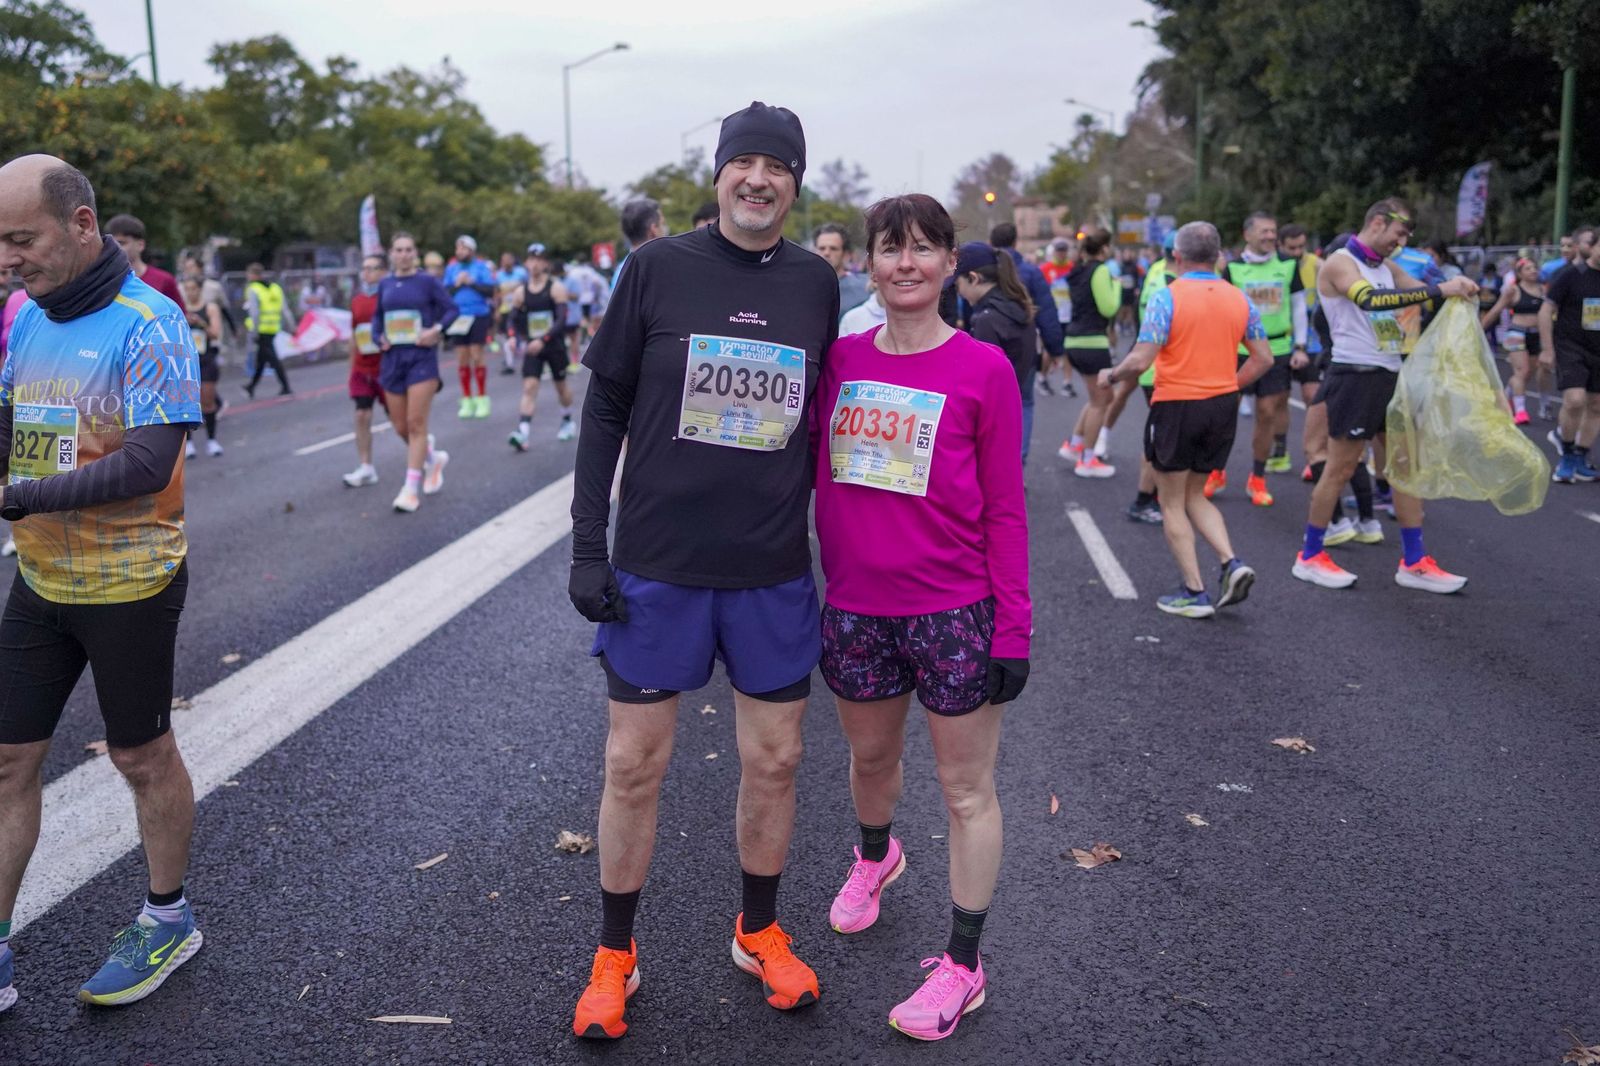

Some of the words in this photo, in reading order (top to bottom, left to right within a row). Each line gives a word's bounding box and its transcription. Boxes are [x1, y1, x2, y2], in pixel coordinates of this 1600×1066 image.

[737, 311, 759, 319] Acid
[729, 316, 768, 326] Running
[731, 342, 773, 354] maratón
[741, 350, 772, 361] sevilla
[695, 362, 787, 404] 20330
[733, 400, 748, 409] Liviu
[835, 406, 917, 444] 20331
[719, 433, 738, 441] HOKA
[11, 429, 57, 461] 827
[861, 439, 879, 448] Helen
